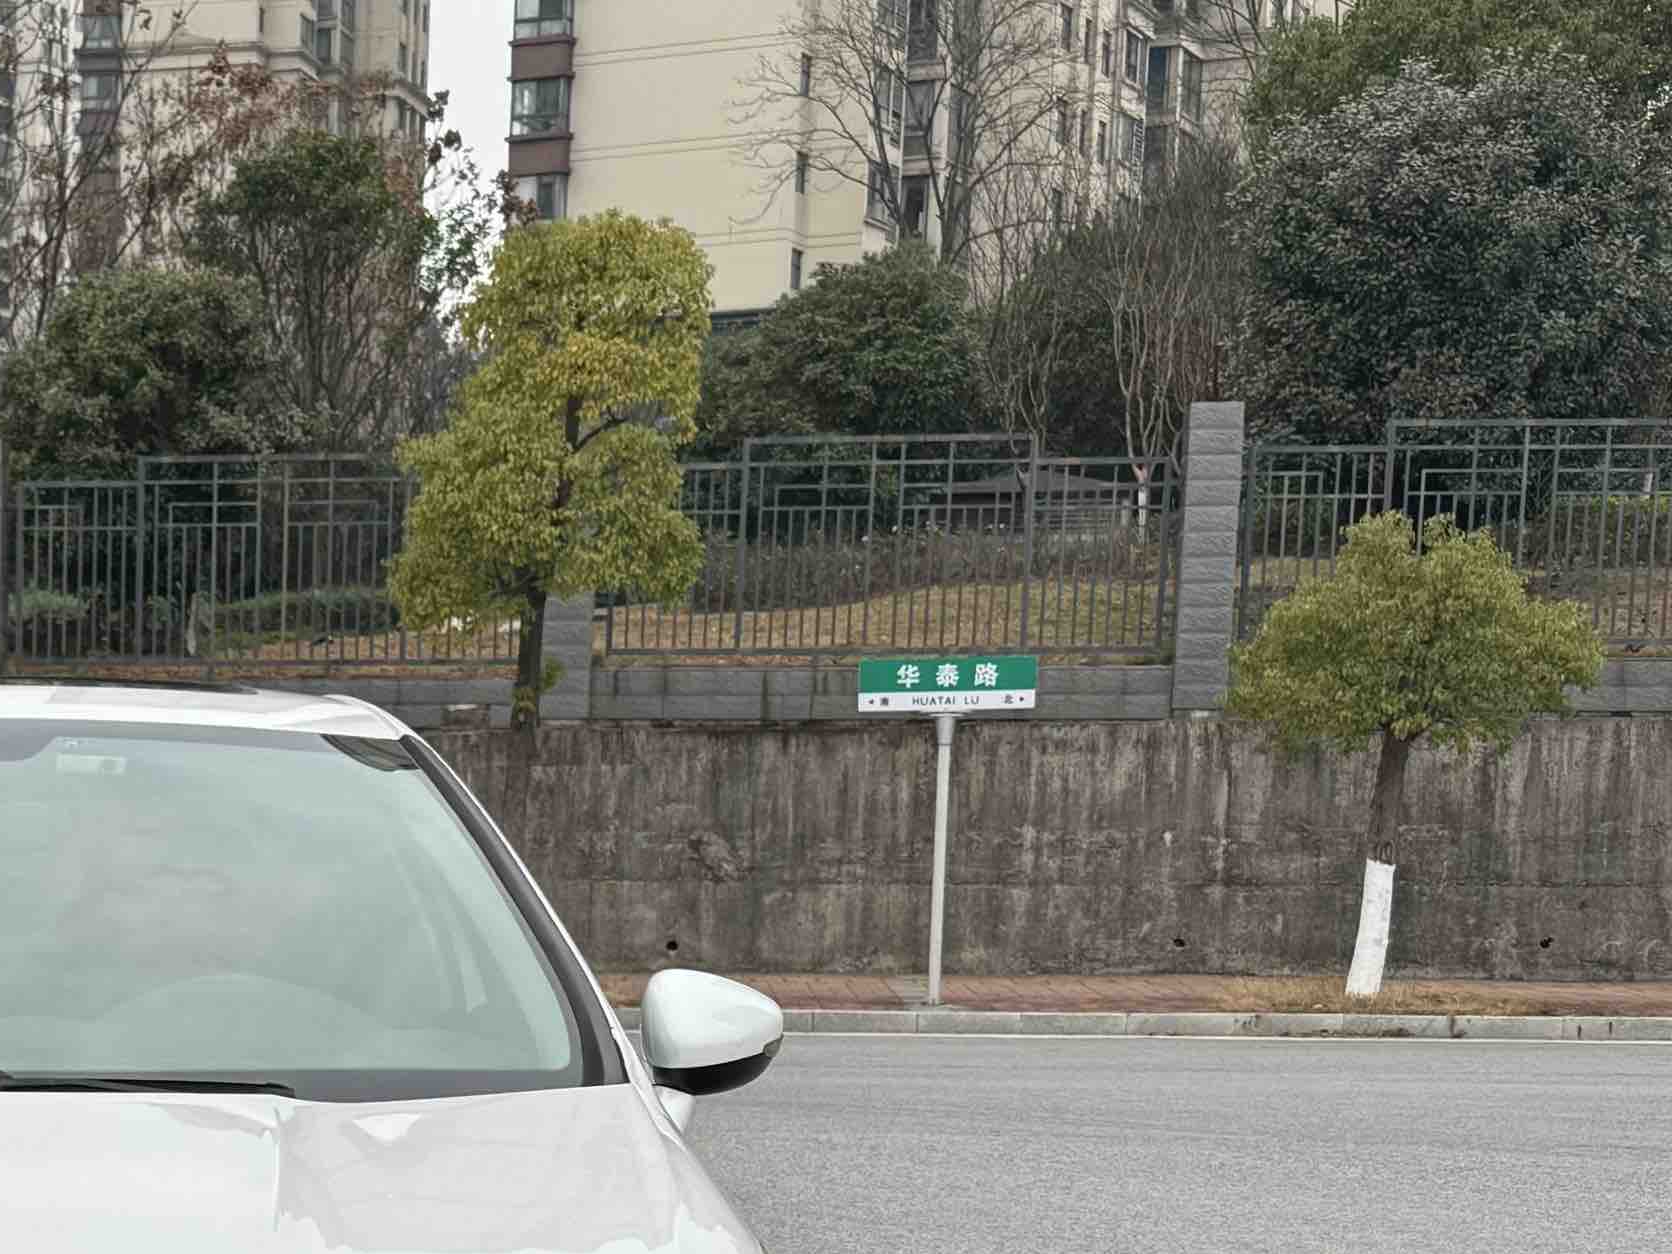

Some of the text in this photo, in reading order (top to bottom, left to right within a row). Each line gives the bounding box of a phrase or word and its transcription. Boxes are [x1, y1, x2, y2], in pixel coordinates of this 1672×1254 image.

[896, 662, 999, 689] 华泰路
[912, 695, 979, 706] HUATAI LU
